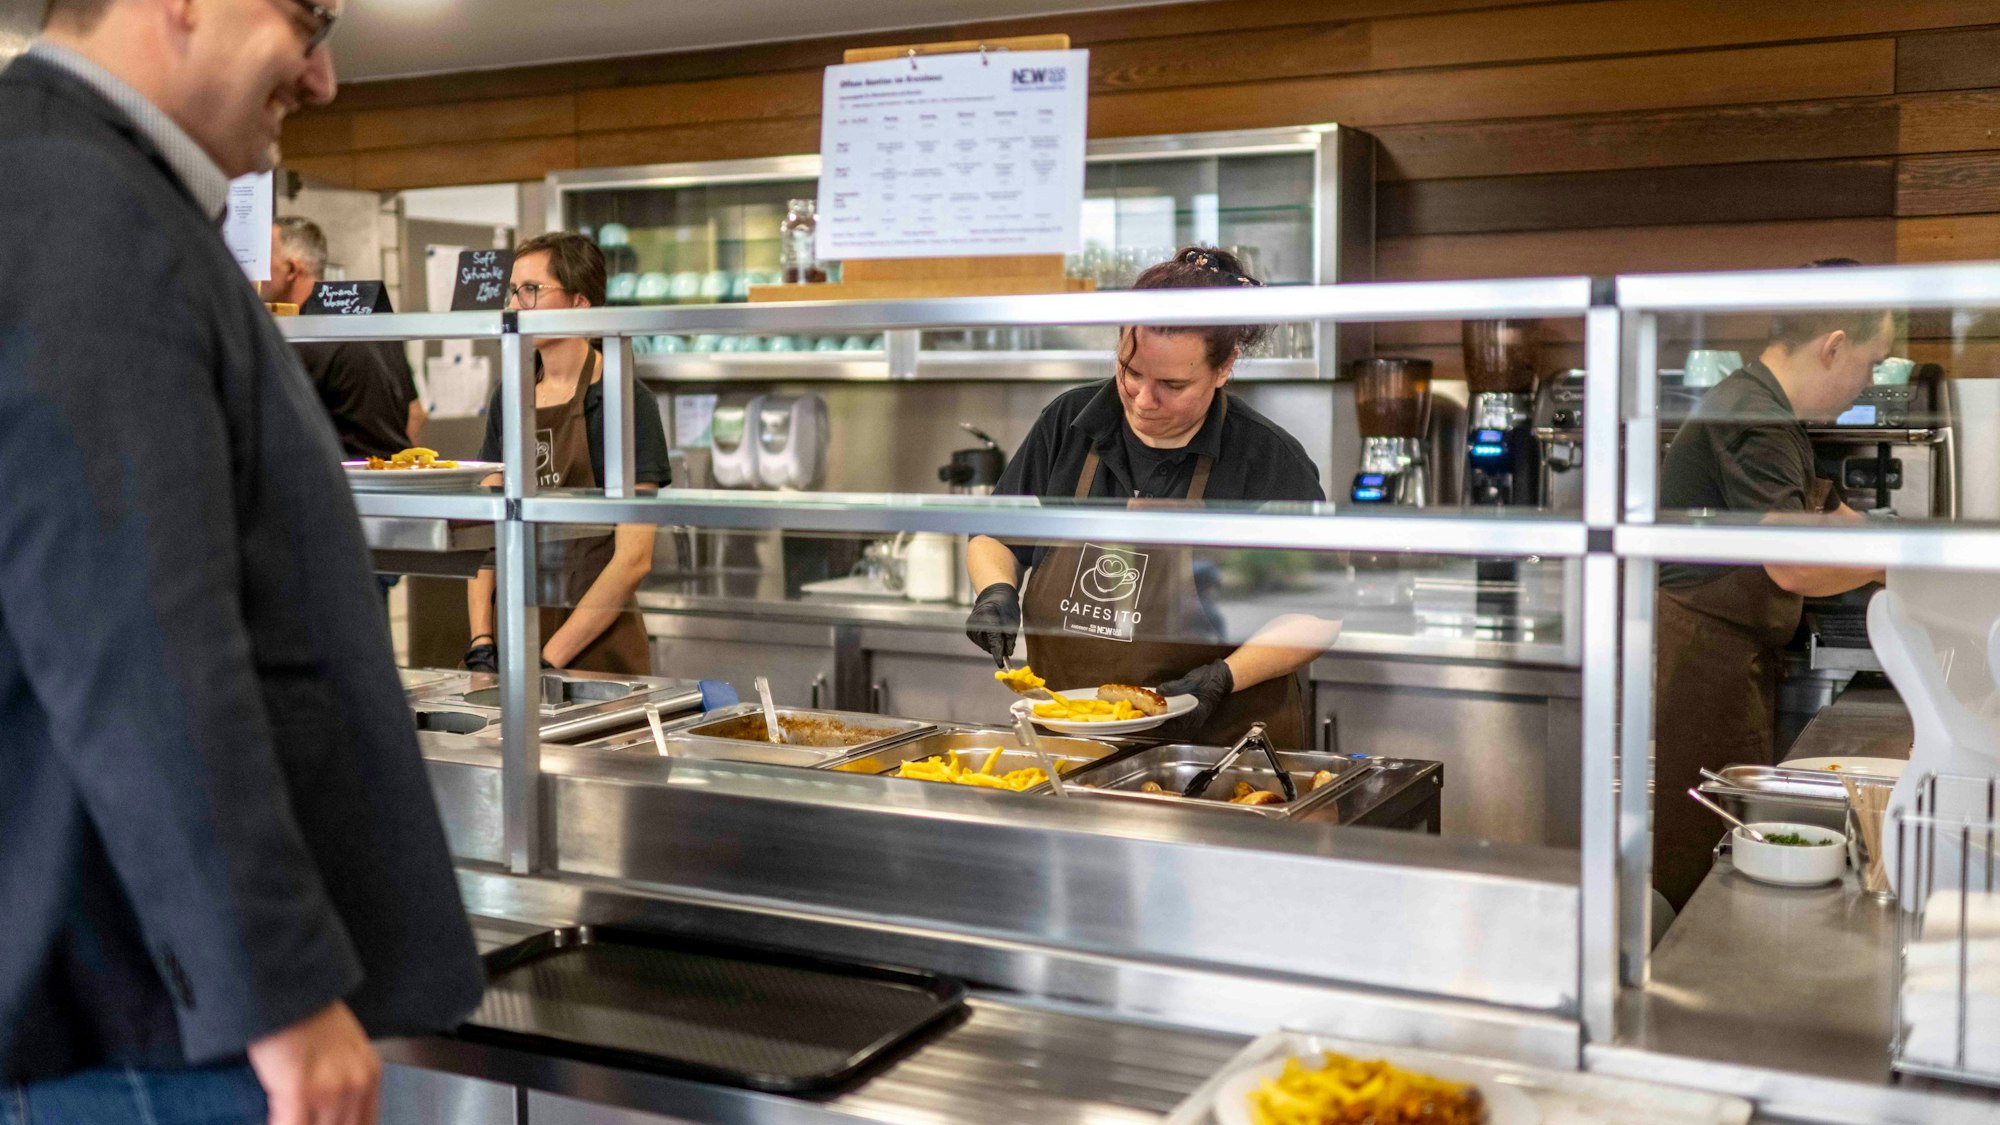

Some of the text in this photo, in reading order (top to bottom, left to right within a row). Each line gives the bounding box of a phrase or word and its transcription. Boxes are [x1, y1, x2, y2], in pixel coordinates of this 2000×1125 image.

[1012, 67, 1047, 85] NEW
[472, 251, 497, 267] Soft
[318, 283, 360, 298] Mineral
[1060, 599, 1142, 624] CAFESITO
[1097, 626, 1112, 636] NEW
